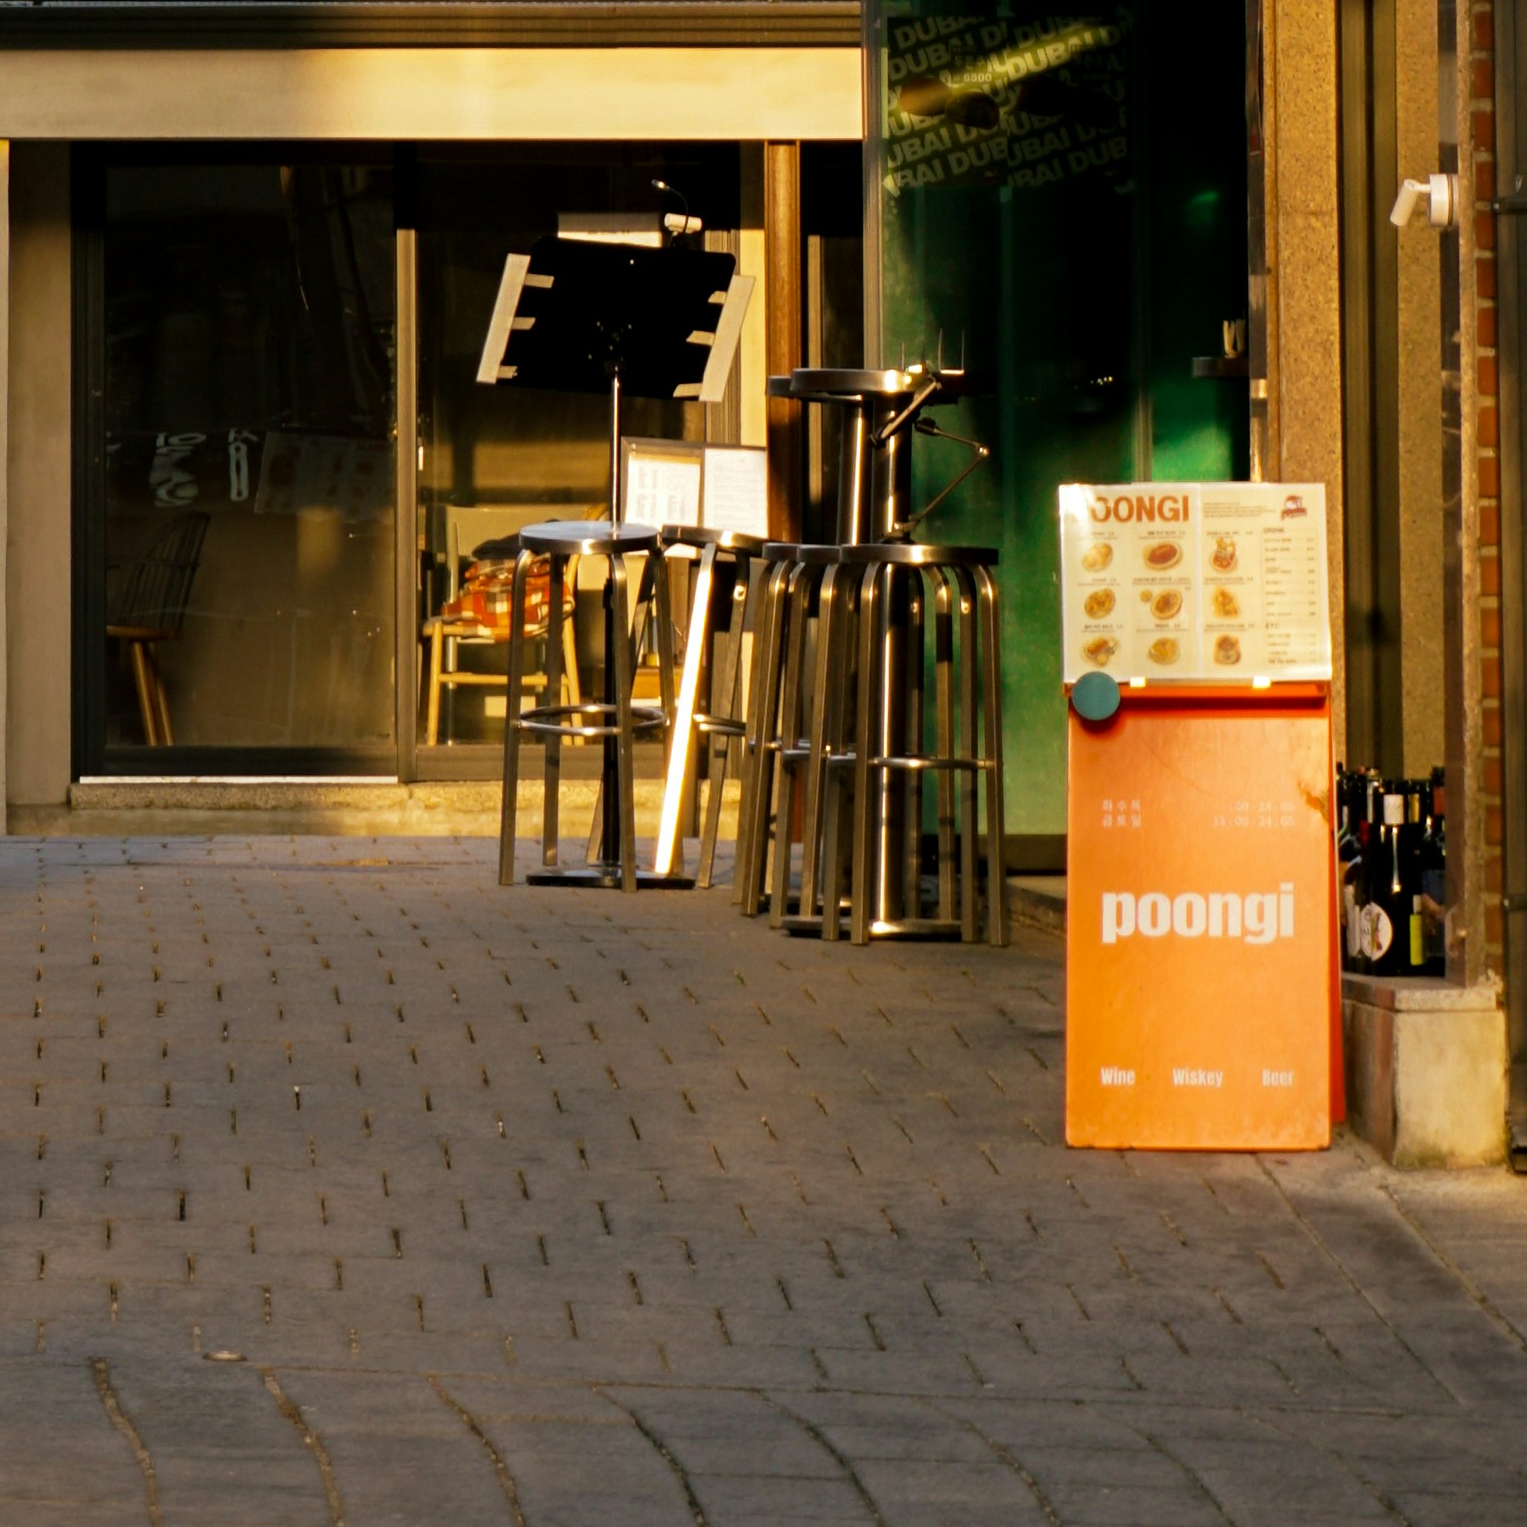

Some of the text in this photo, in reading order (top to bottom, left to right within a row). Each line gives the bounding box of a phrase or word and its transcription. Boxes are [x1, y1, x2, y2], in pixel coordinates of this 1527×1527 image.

[1102, 882, 1294, 944] poongi
[1100, 1067, 1294, 1088] Wine Wiskey Beer
